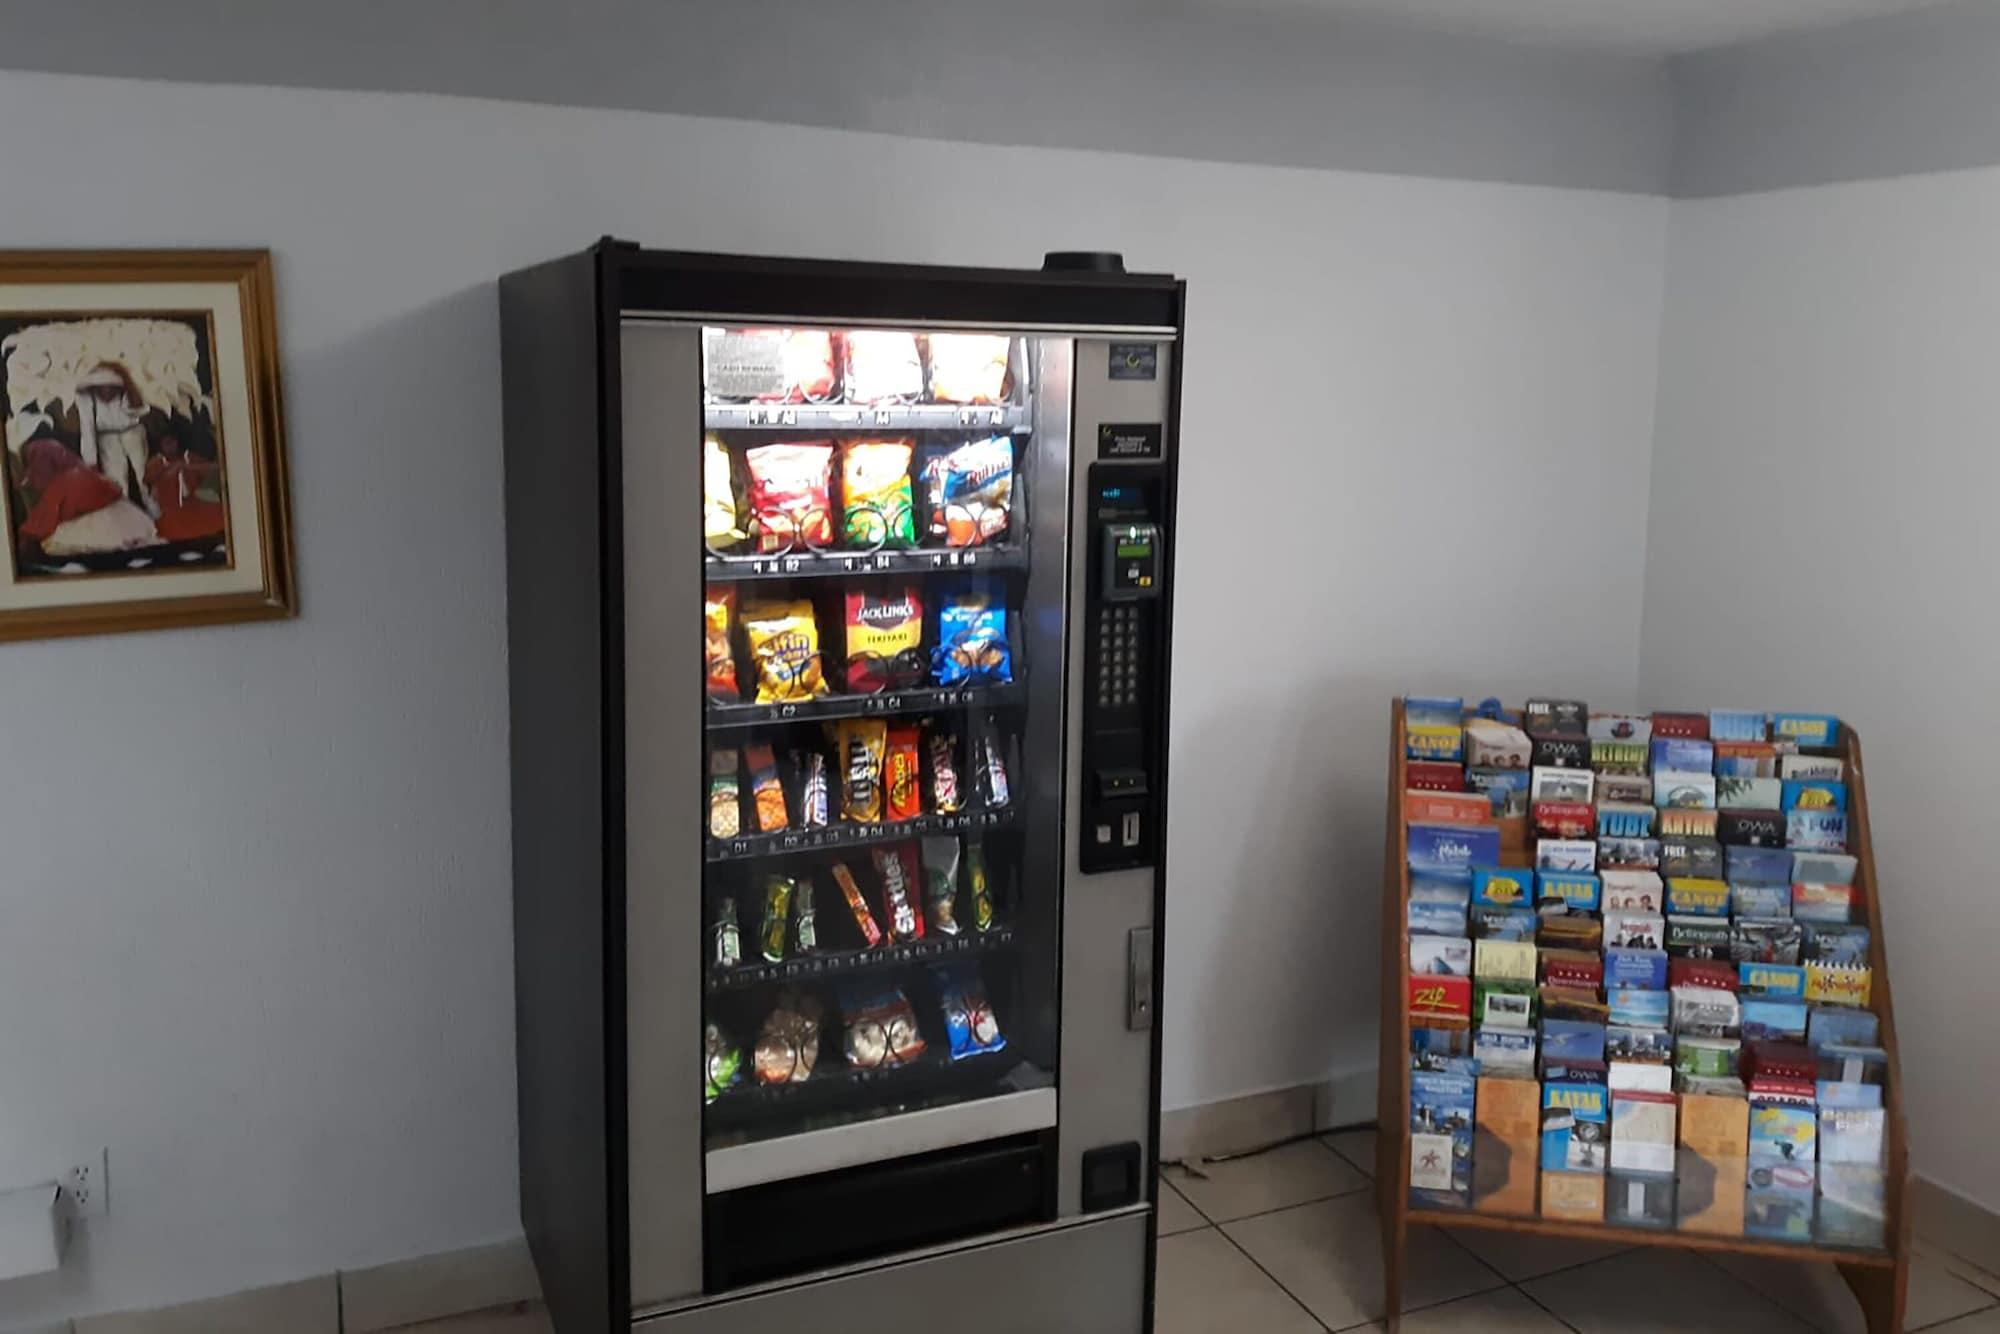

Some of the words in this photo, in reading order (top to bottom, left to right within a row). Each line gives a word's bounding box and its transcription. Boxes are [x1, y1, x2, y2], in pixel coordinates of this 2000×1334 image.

[867, 632, 908, 644] TERIYAKI
[1528, 702, 1550, 715] FREE
[1664, 844, 1687, 857] FREE
